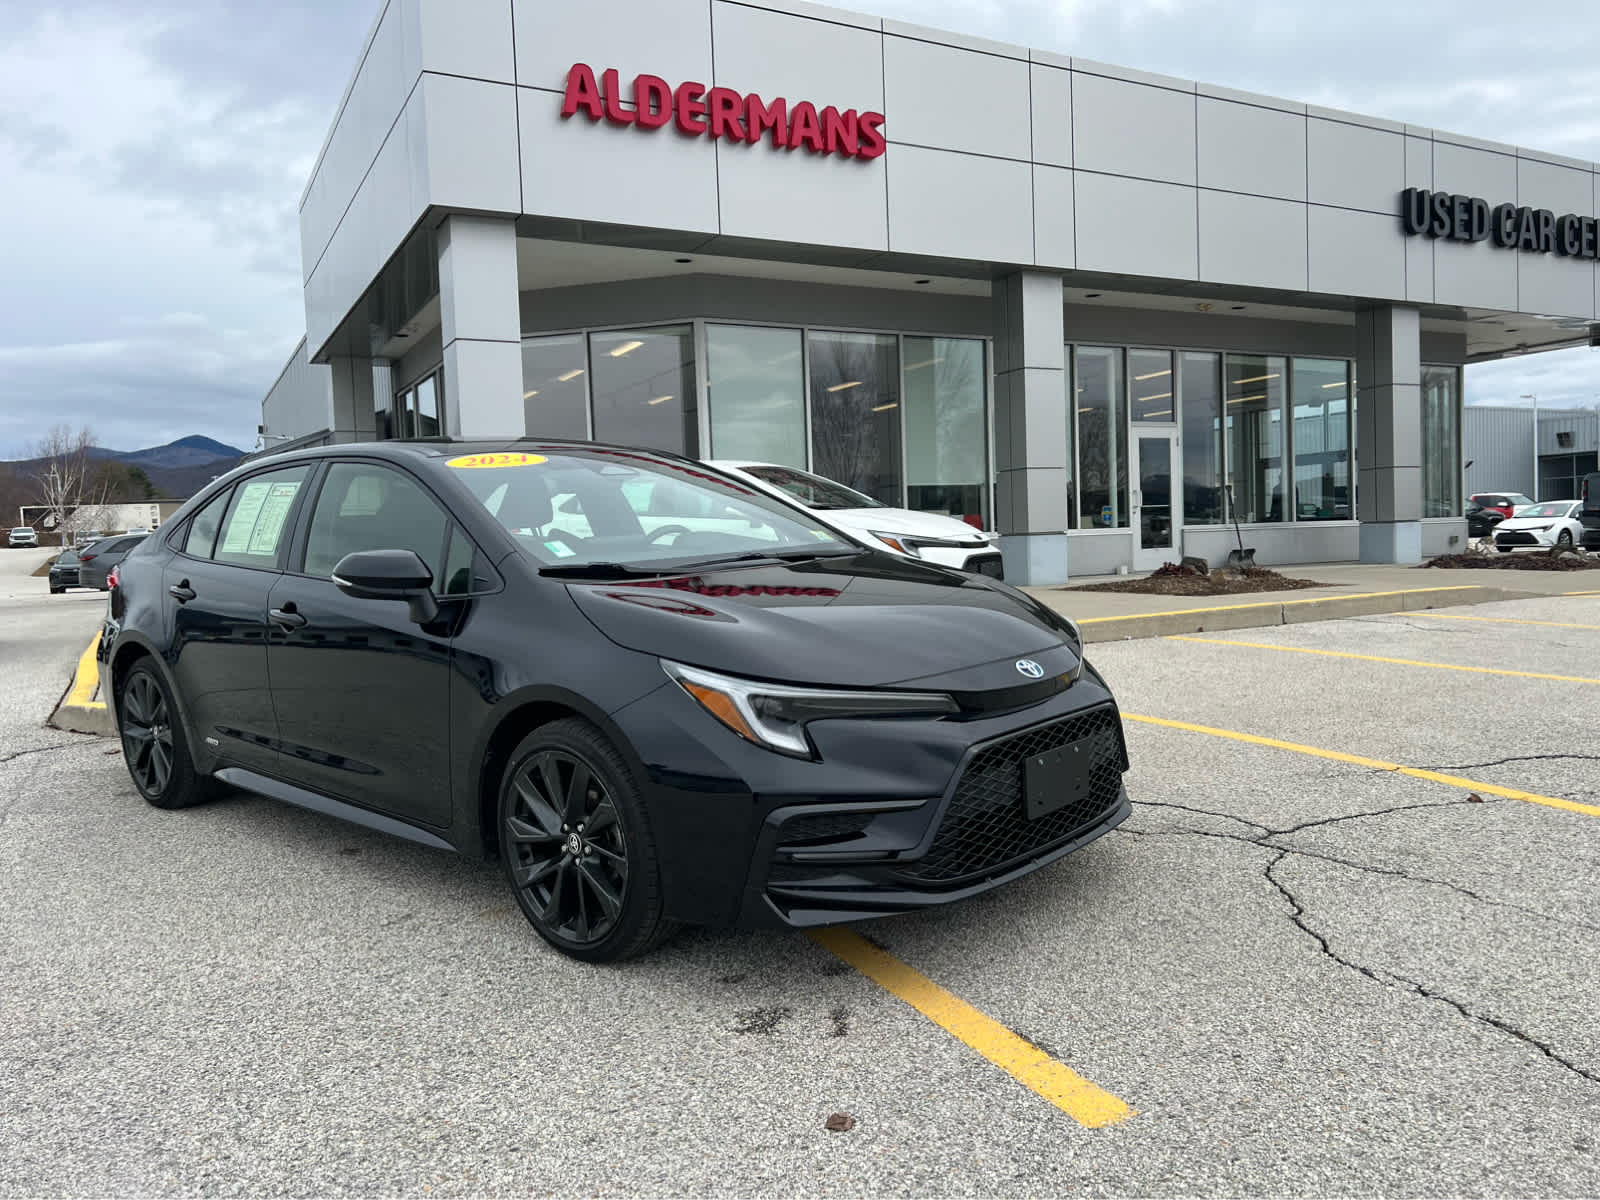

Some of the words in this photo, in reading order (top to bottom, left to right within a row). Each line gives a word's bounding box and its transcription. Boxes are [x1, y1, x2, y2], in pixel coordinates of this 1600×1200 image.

[561, 63, 887, 159] ALDERMANS
[1402, 187, 1490, 242] USED
[1493, 202, 1556, 252] CAR
[463, 455, 528, 467] 2024
